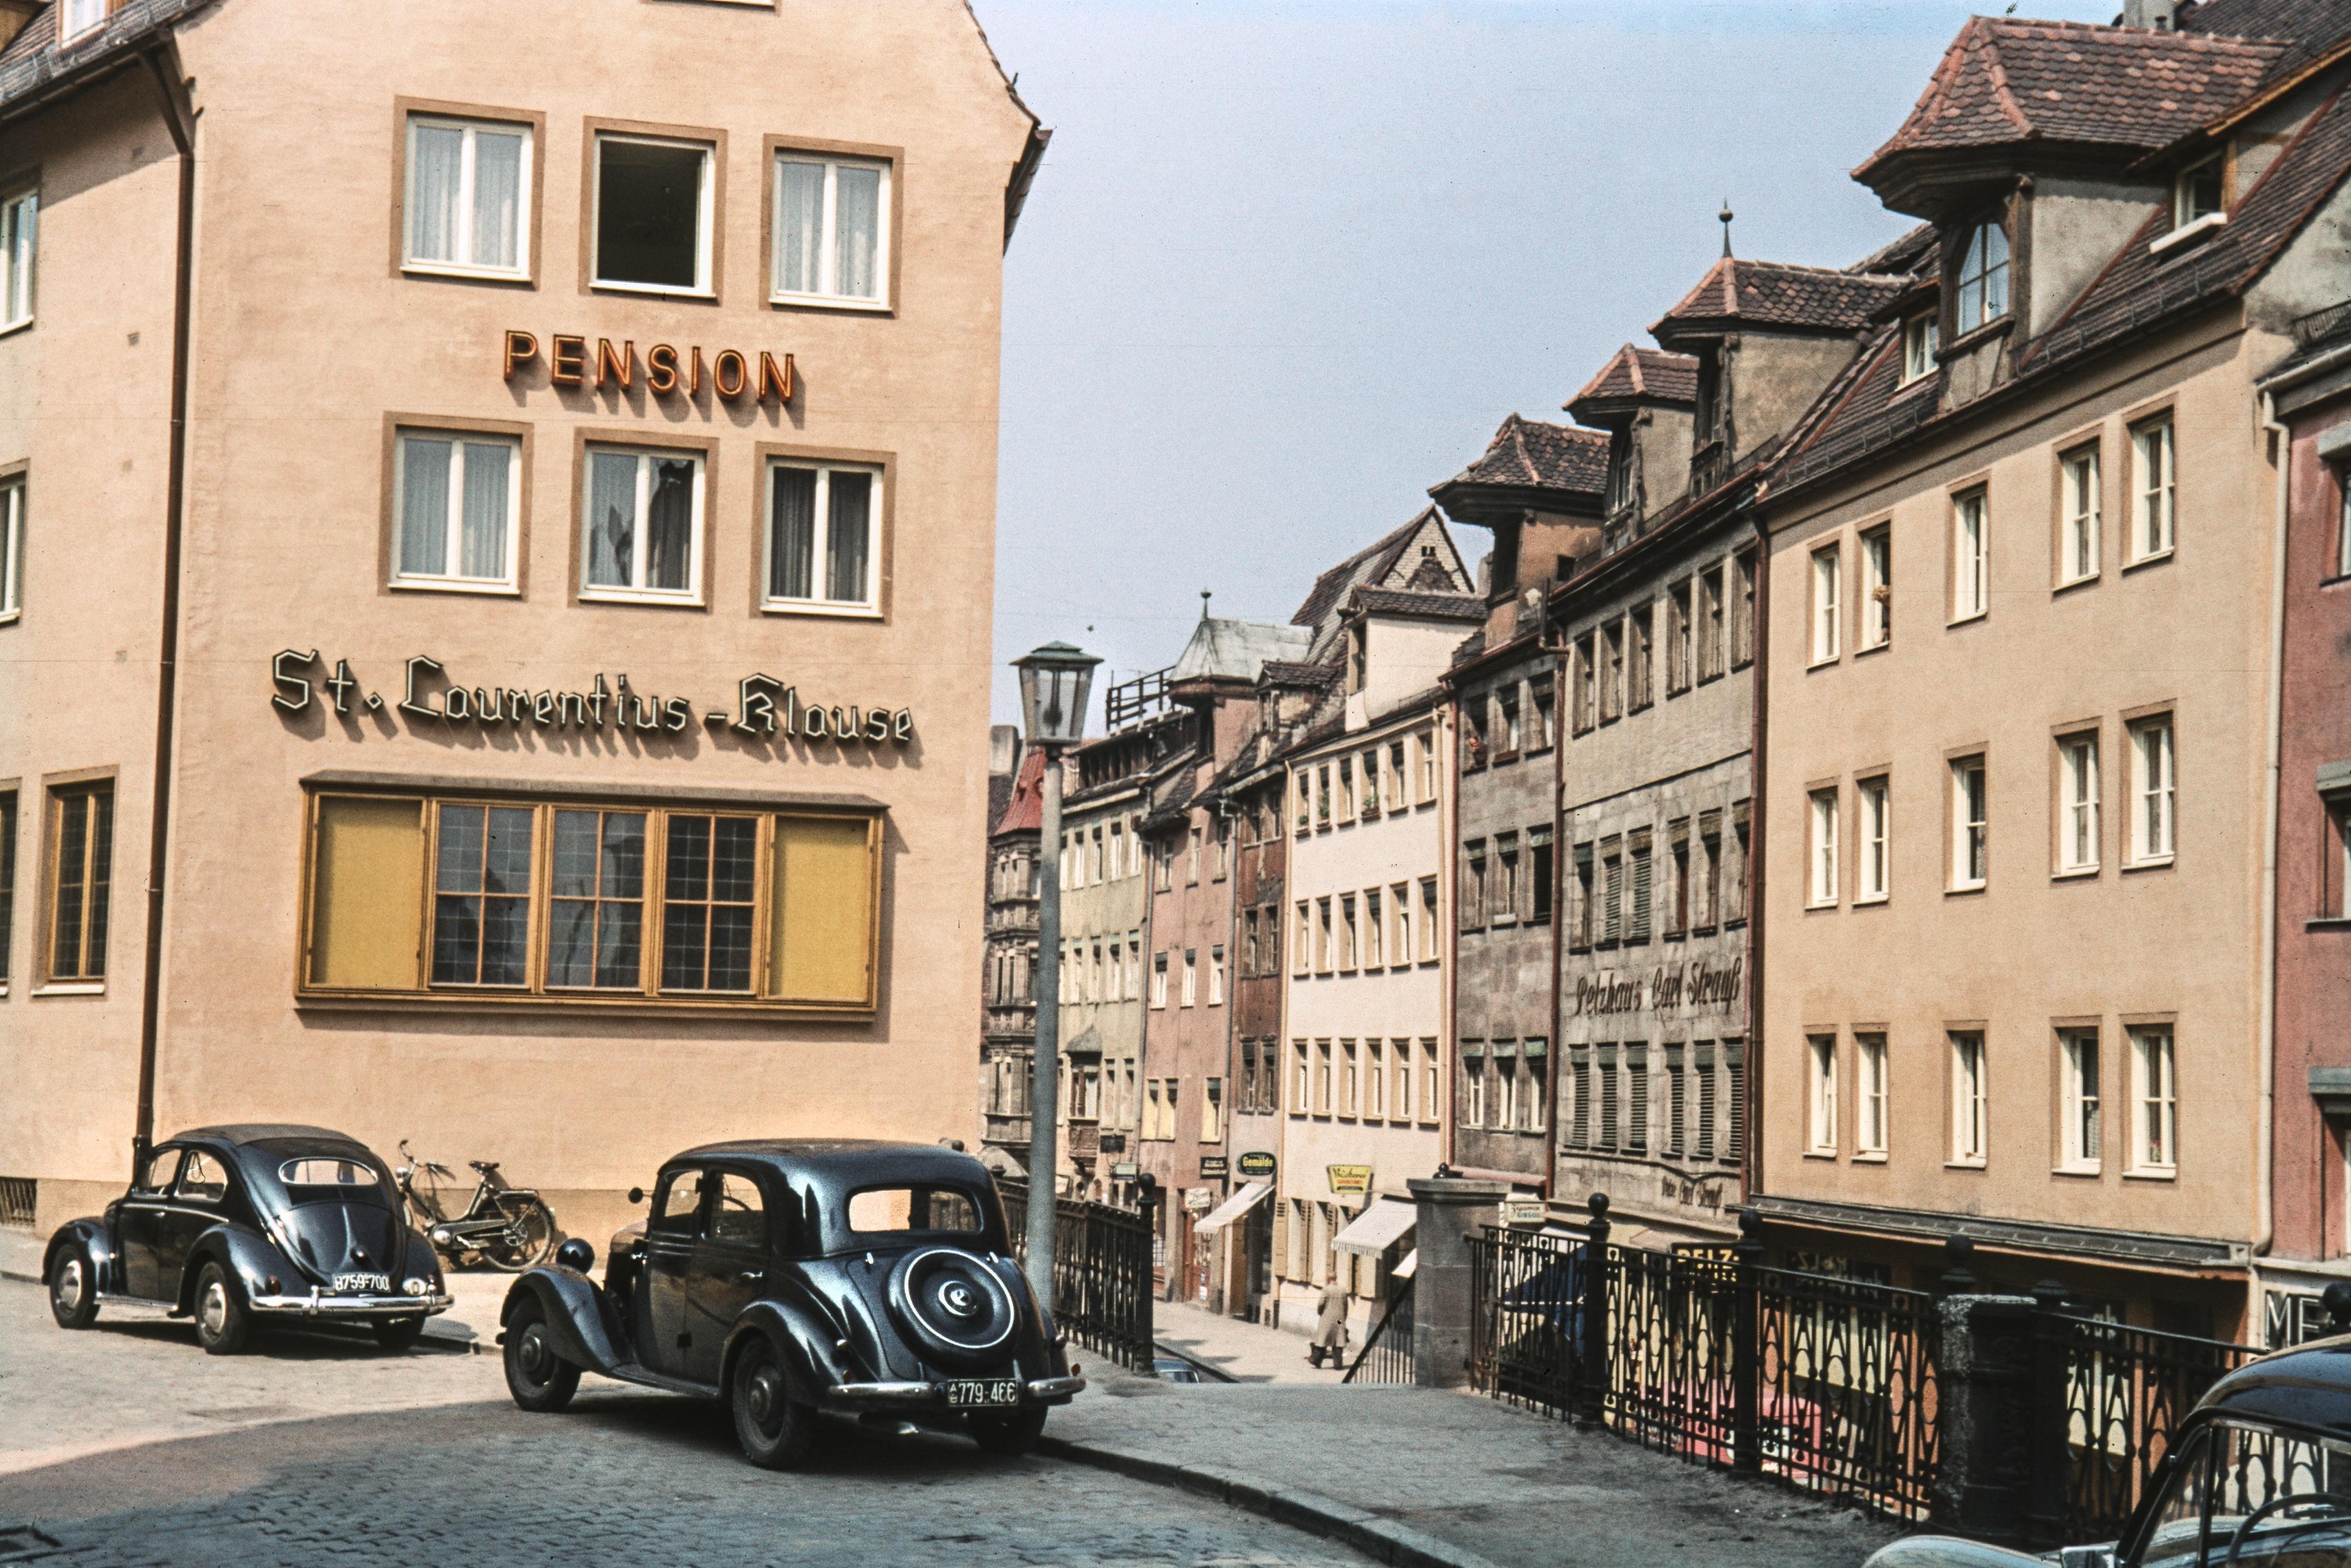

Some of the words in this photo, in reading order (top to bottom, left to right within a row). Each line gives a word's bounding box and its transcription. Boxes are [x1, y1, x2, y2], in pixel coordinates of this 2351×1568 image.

[503, 330, 795, 403] PENSION
[271, 648, 384, 715] St.
[1575, 972, 1642, 1016] Pelzhaus
[1651, 962, 1685, 1009] Carl
[1686, 957, 1742, 1015] Strauß
[1242, 1156, 1273, 1167] Gemälde
